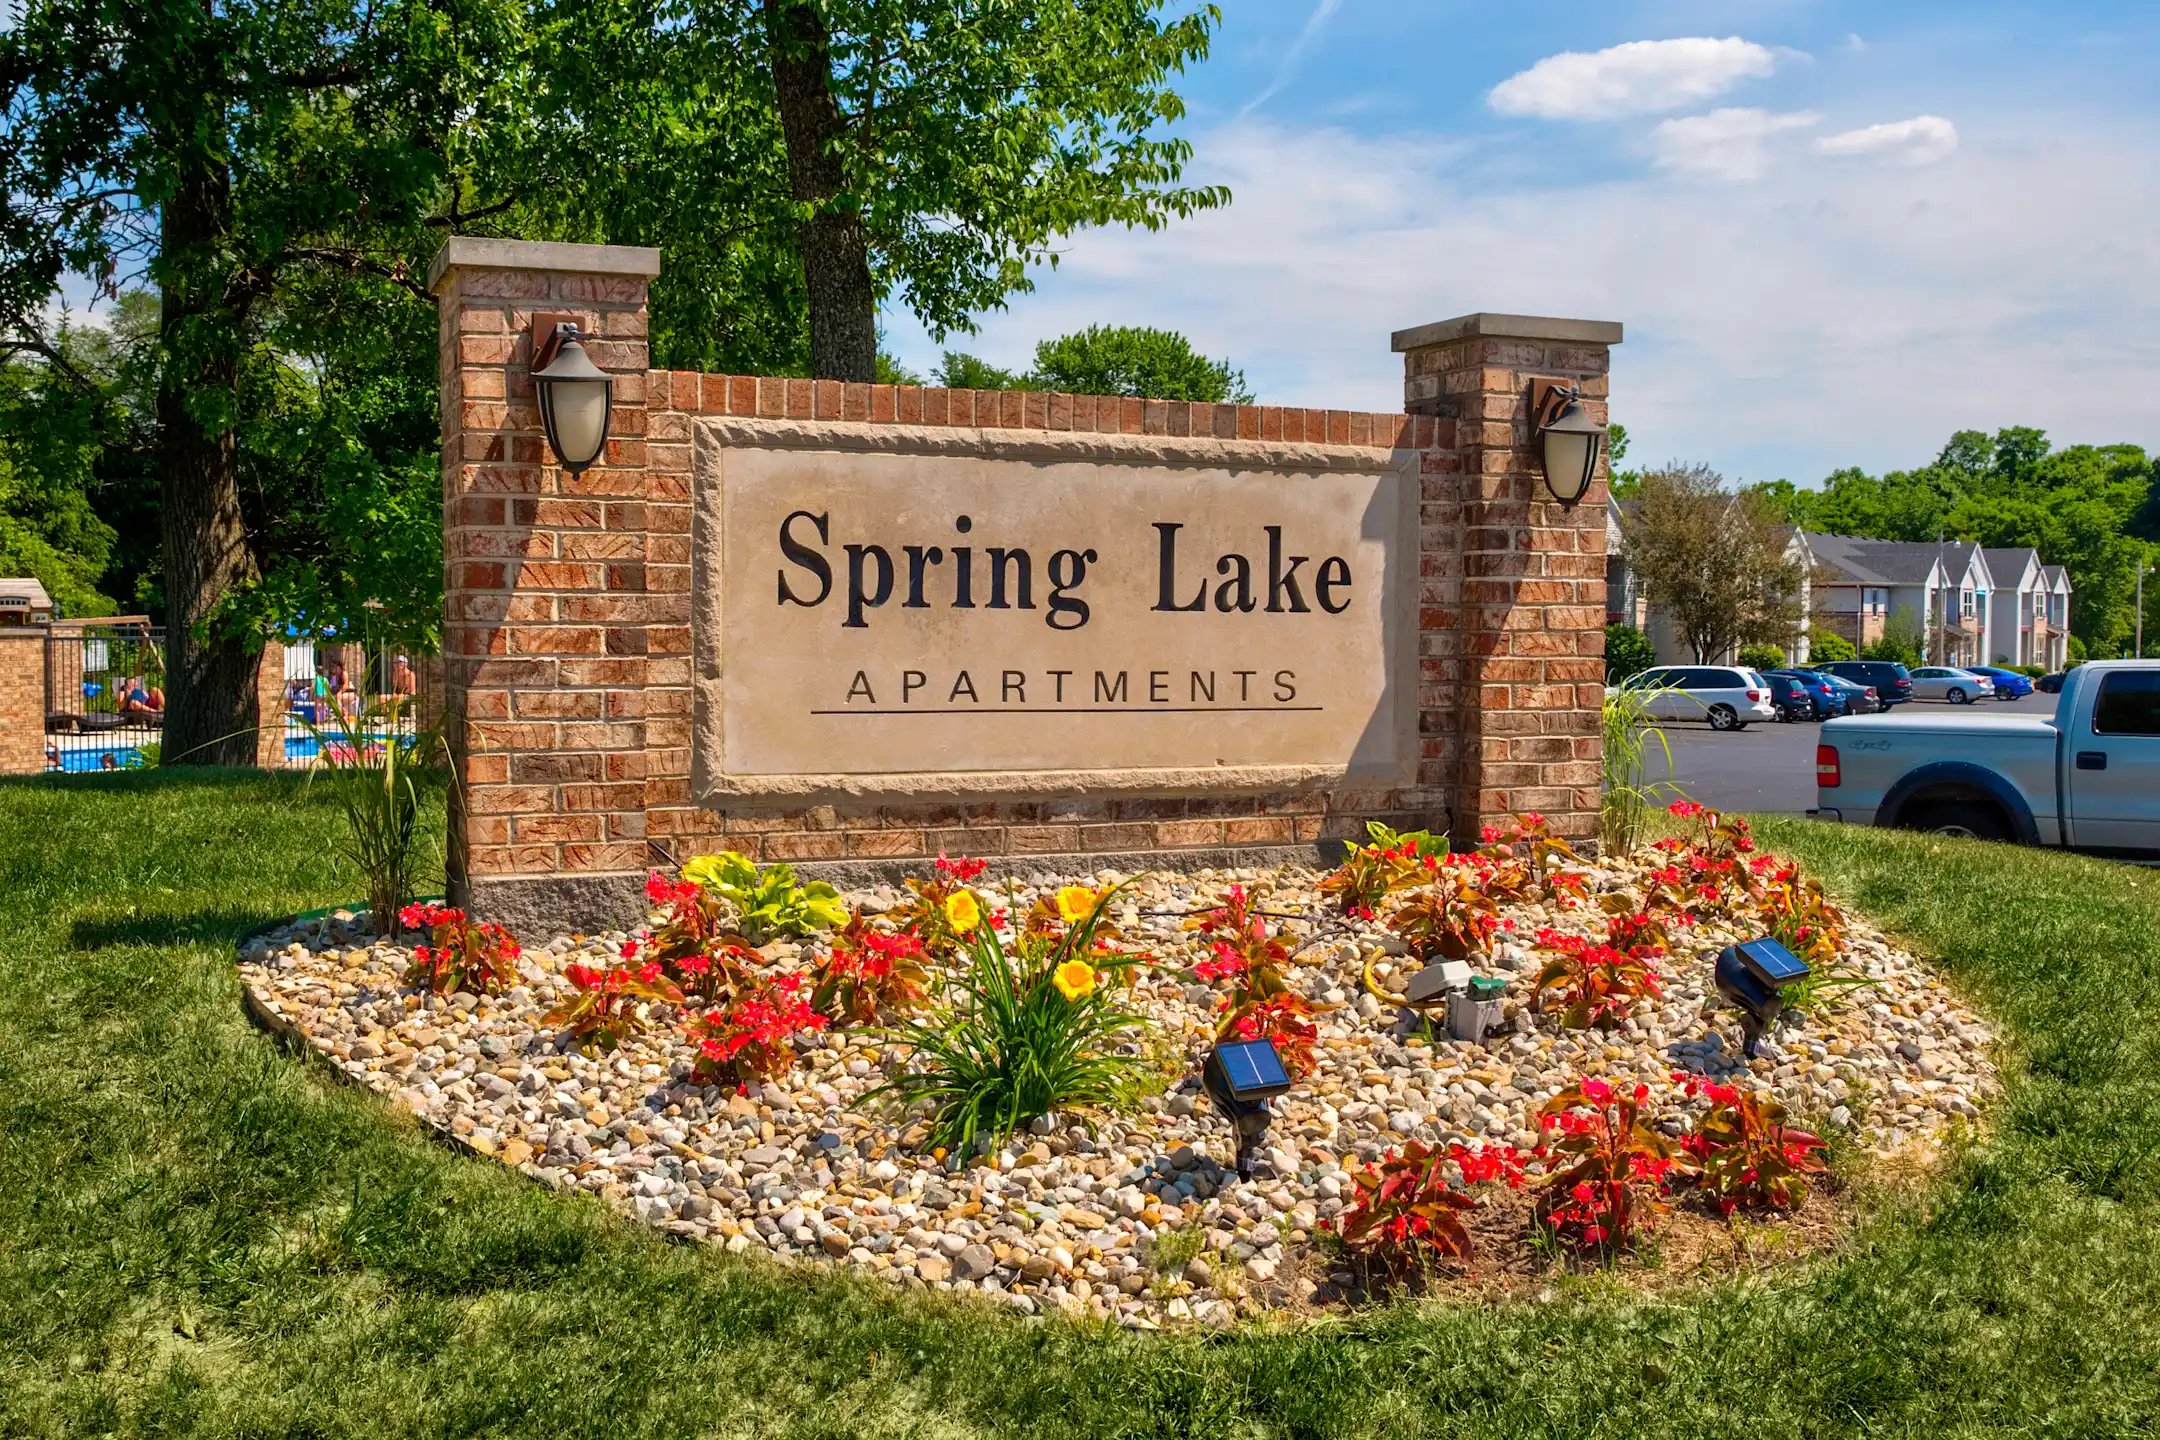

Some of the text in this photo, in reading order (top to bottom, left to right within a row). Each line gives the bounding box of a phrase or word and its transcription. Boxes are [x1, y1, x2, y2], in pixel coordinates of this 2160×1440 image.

[777, 510, 1352, 631] Spring Lake
[845, 669, 1297, 704] APARTMENTS
